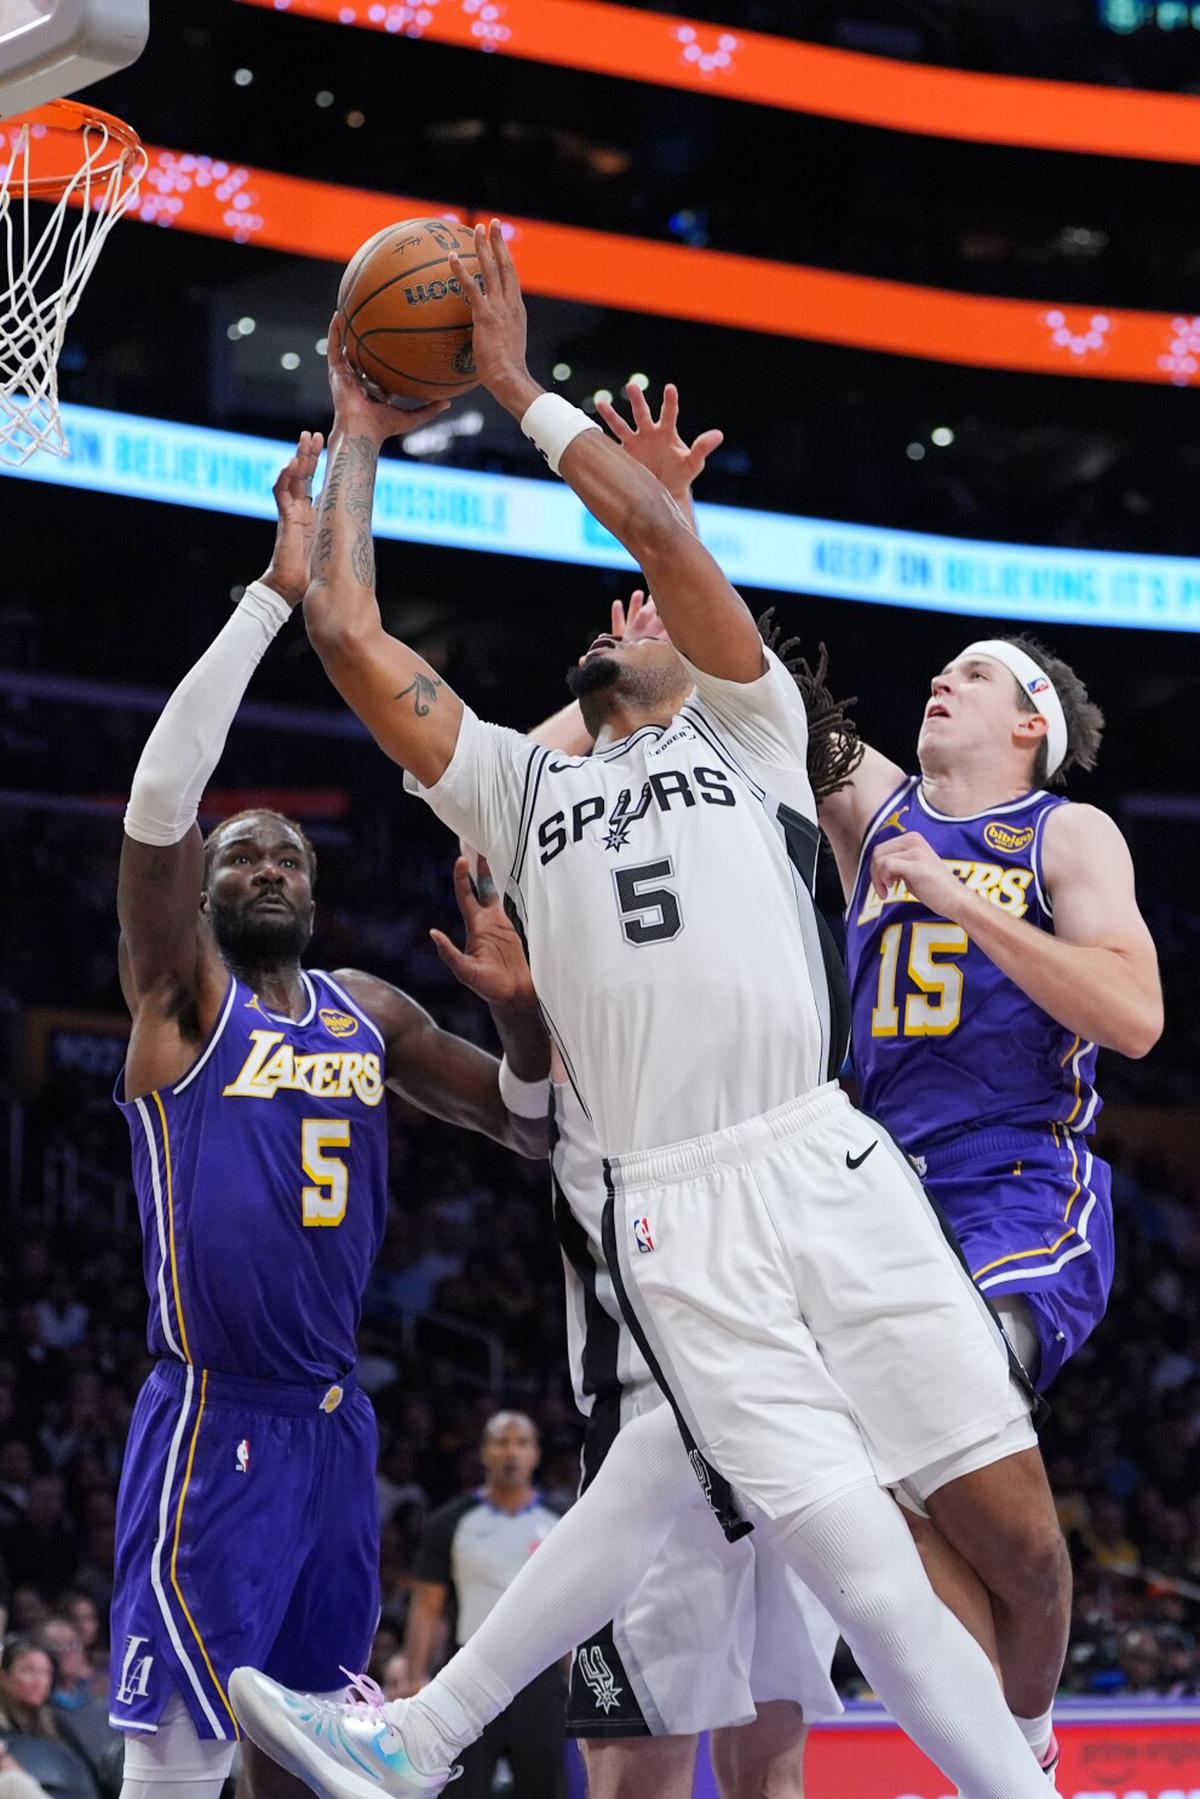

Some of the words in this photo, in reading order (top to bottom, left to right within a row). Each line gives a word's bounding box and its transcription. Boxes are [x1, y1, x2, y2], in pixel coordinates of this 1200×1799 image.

[376, 475, 507, 534] OSSIBLE
[814, 541, 883, 580] KEEP
[899, 553, 934, 588] ON
[946, 555, 1101, 604] BELIEVING
[538, 766, 736, 866] SPURS
[610, 854, 685, 948] 5
[871, 921, 969, 1037] 15
[302, 1118, 351, 1227] 5
[116, 1635, 154, 1705] LA
